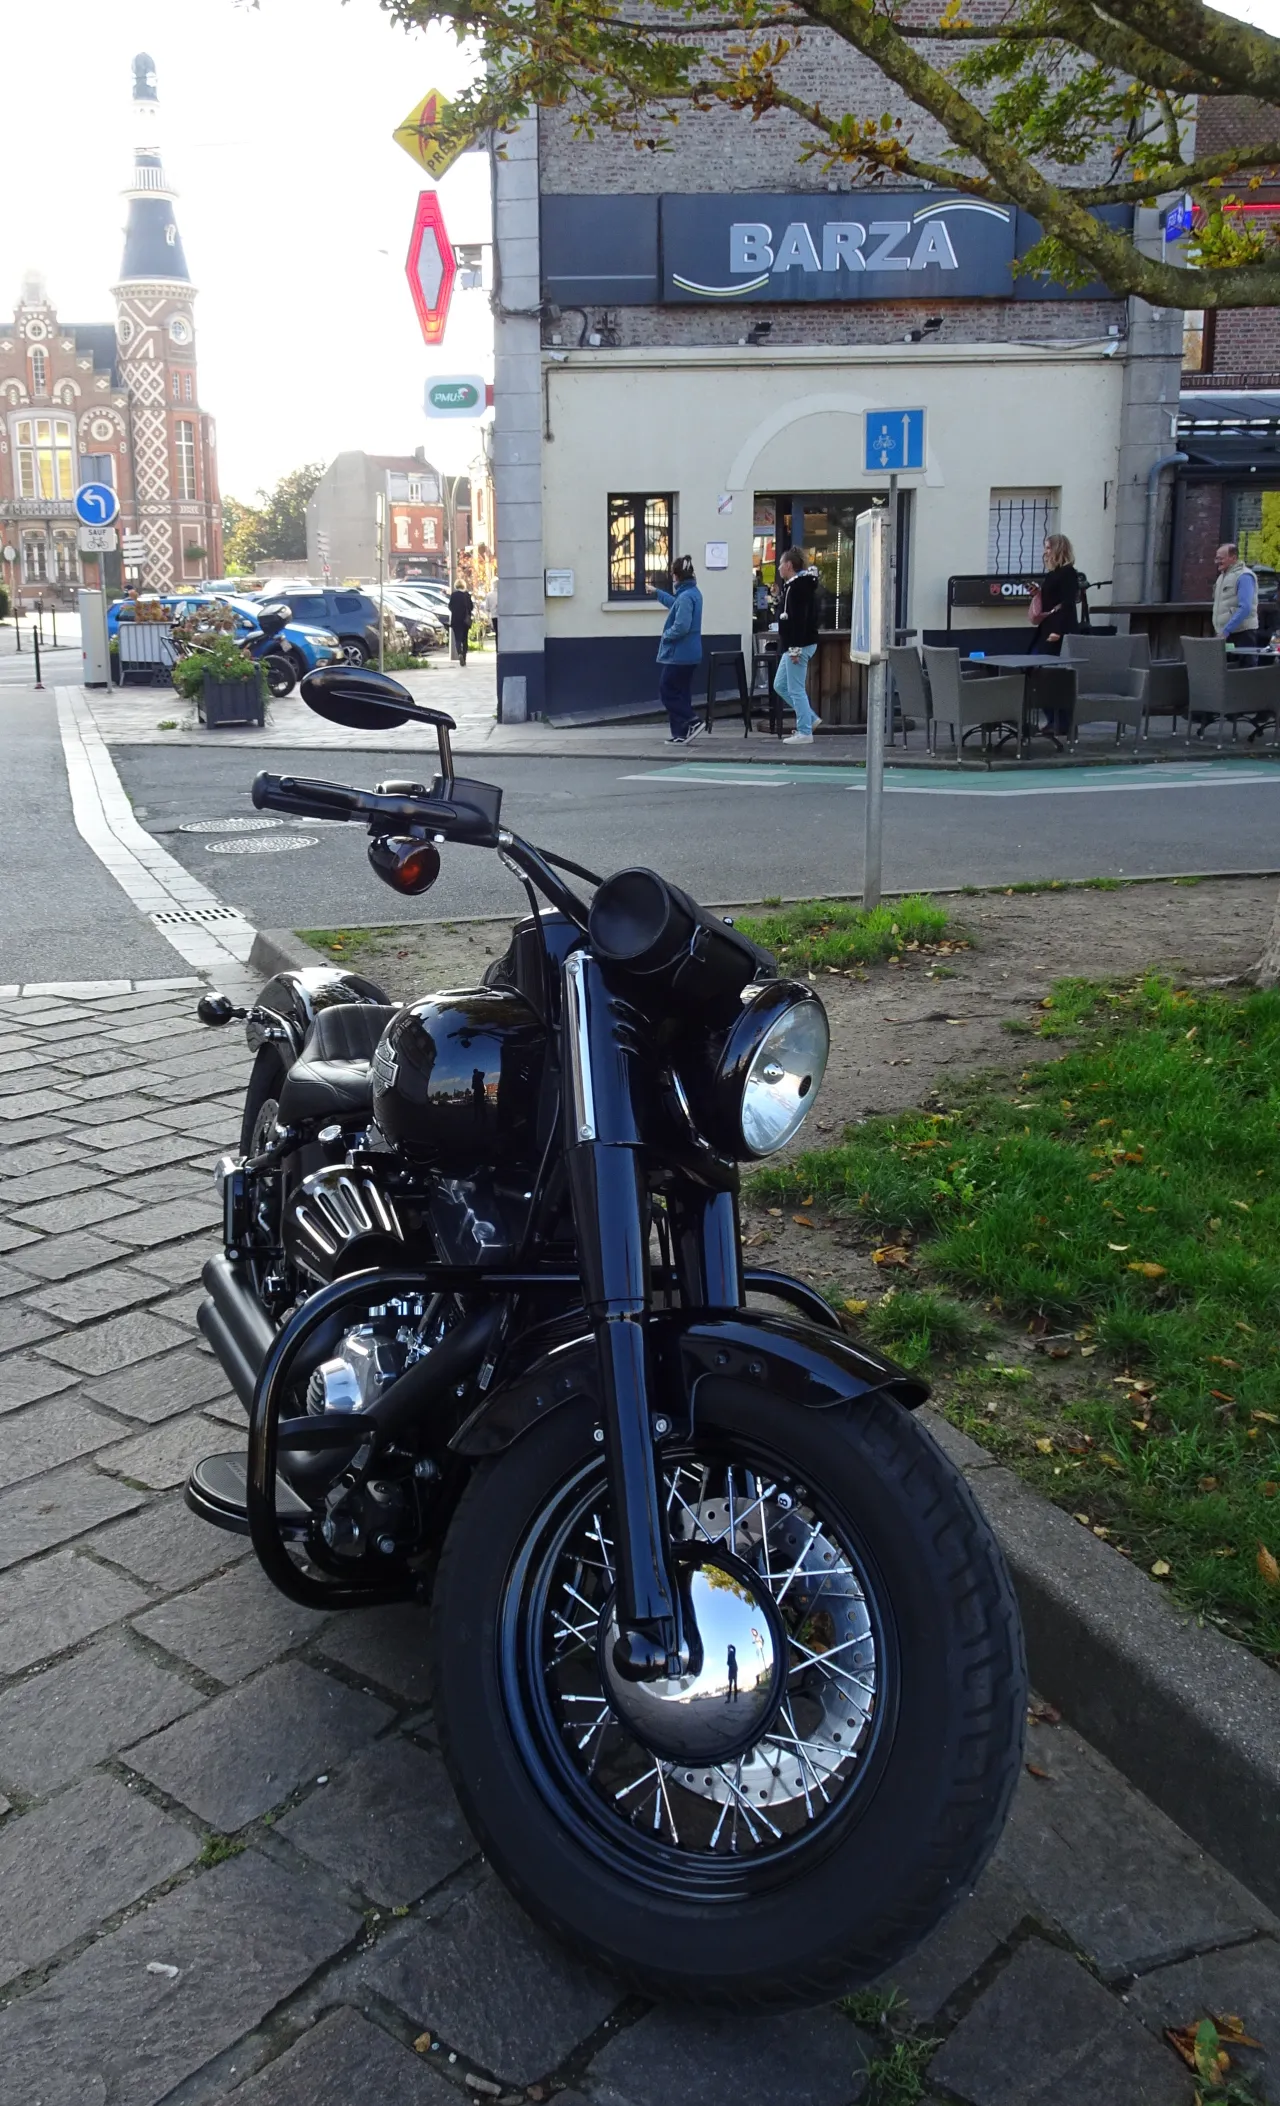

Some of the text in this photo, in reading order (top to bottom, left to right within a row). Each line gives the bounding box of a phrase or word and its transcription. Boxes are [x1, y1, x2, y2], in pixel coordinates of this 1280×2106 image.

[730, 221, 959, 273] BARZA
[434, 392, 459, 402] PMU
[1001, 583, 1031, 596] OME
